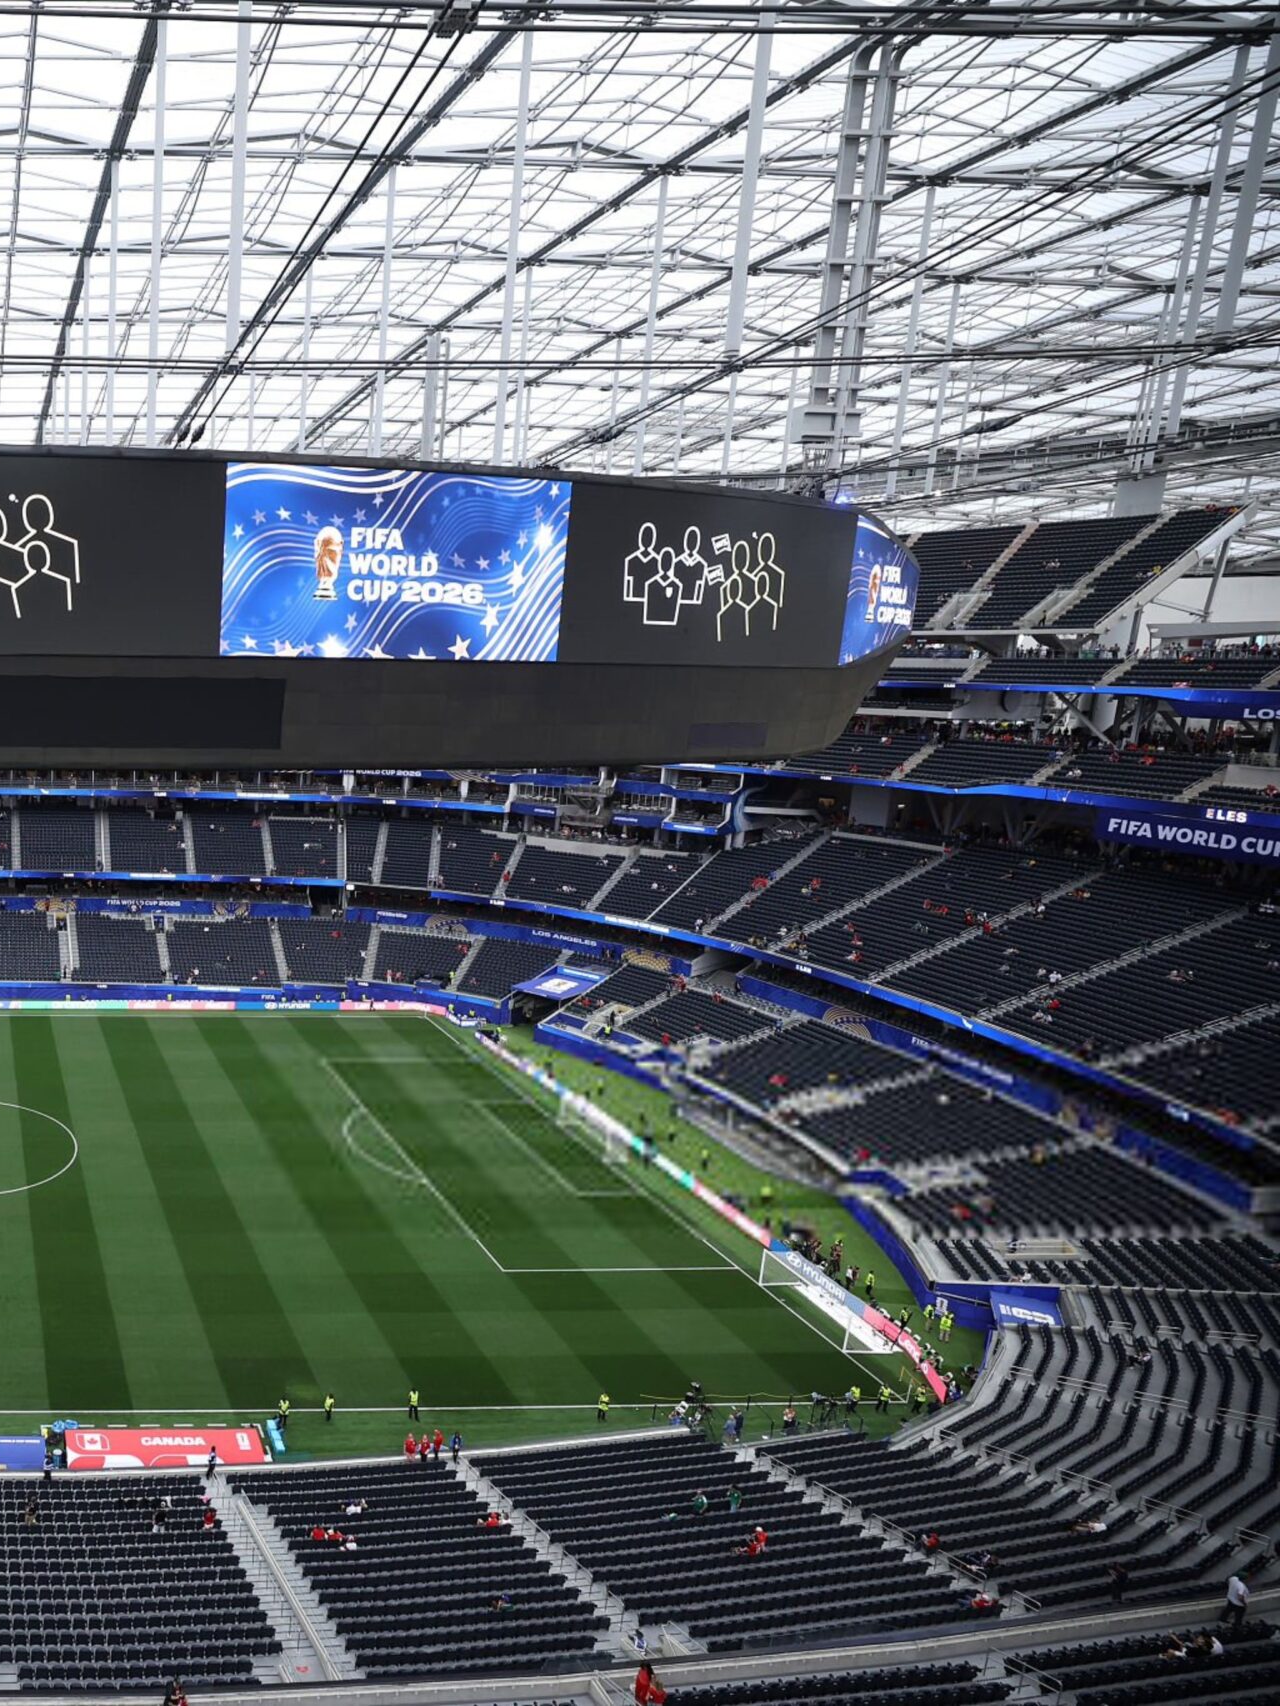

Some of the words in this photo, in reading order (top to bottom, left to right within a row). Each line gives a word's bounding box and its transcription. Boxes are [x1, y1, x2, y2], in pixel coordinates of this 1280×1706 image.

[350, 527, 404, 550] FIFA
[349, 553, 439, 577] WORLD
[347, 579, 399, 603] CUP
[401, 581, 485, 605] 2026
[1107, 818, 1152, 838] FIFA
[1157, 824, 1237, 850] WORLD
[532, 929, 551, 938] LOS
[552, 933, 597, 947] ANGELES
[803, 1262, 847, 1303] HYUNDAI
[141, 1436, 207, 1446] CANADA
